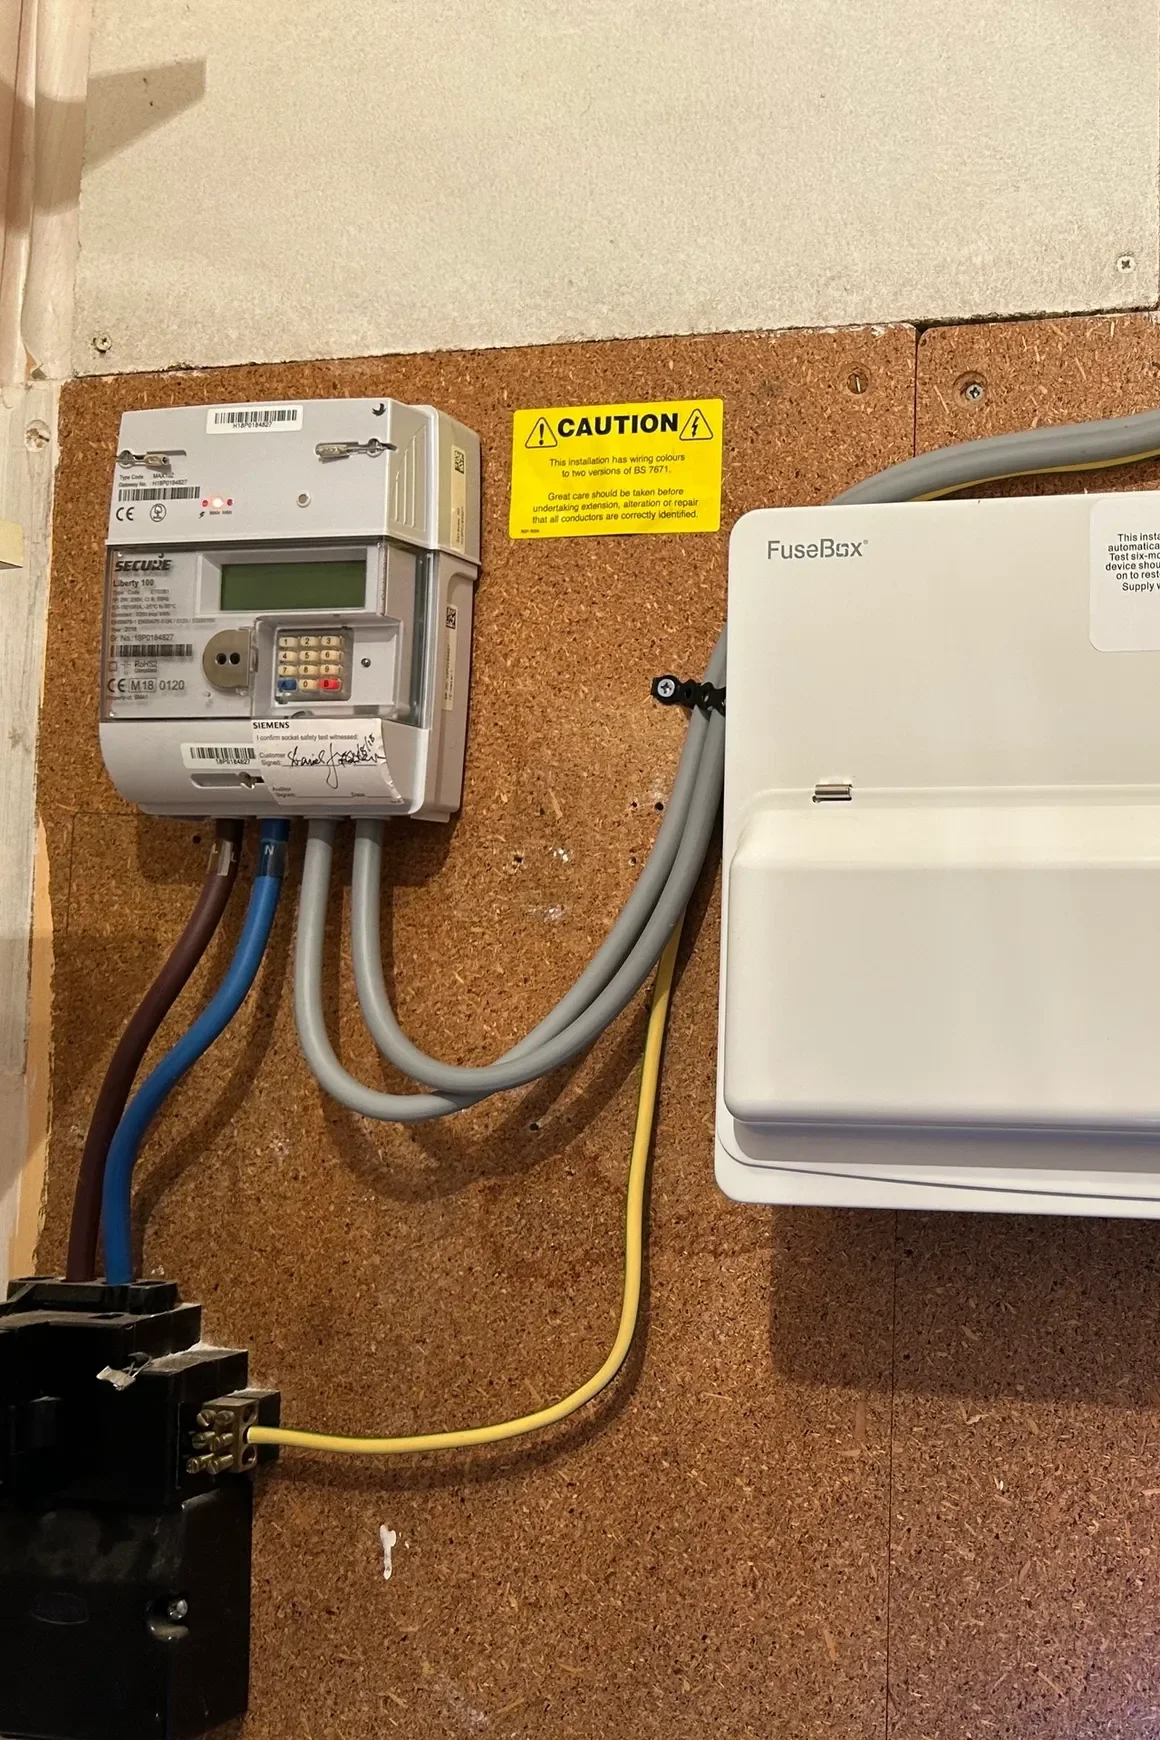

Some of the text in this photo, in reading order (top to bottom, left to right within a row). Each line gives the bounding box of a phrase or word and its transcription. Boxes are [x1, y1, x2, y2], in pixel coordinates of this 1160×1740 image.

[557, 413, 677, 437] CAUTION
[550, 454, 685, 466] This installation has wiring colours
[588, 468, 621, 476] versions
[634, 466, 646, 474] BS
[649, 465, 670, 473] 7671.
[548, 492, 570, 500] Great
[591, 489, 617, 498] should
[633, 488, 655, 496] taken
[533, 504, 579, 512] undertaking
[581, 501, 620, 510] extension,
[623, 500, 660, 508] alteration
[674, 499, 698, 507] repair
[549, 515, 558, 523] all
[561, 514, 603, 522] conductors
[621, 512, 655, 520] correctly
[658, 510, 697, 518] identified.
[1117, 533, 1137, 541] This
[768, 538, 862, 559] FuseBox
[115, 560, 172, 572] SECURE
[113, 580, 139, 588] Liberty
[1122, 581, 1154, 592] Supply
[160, 680, 185, 690] 0120
